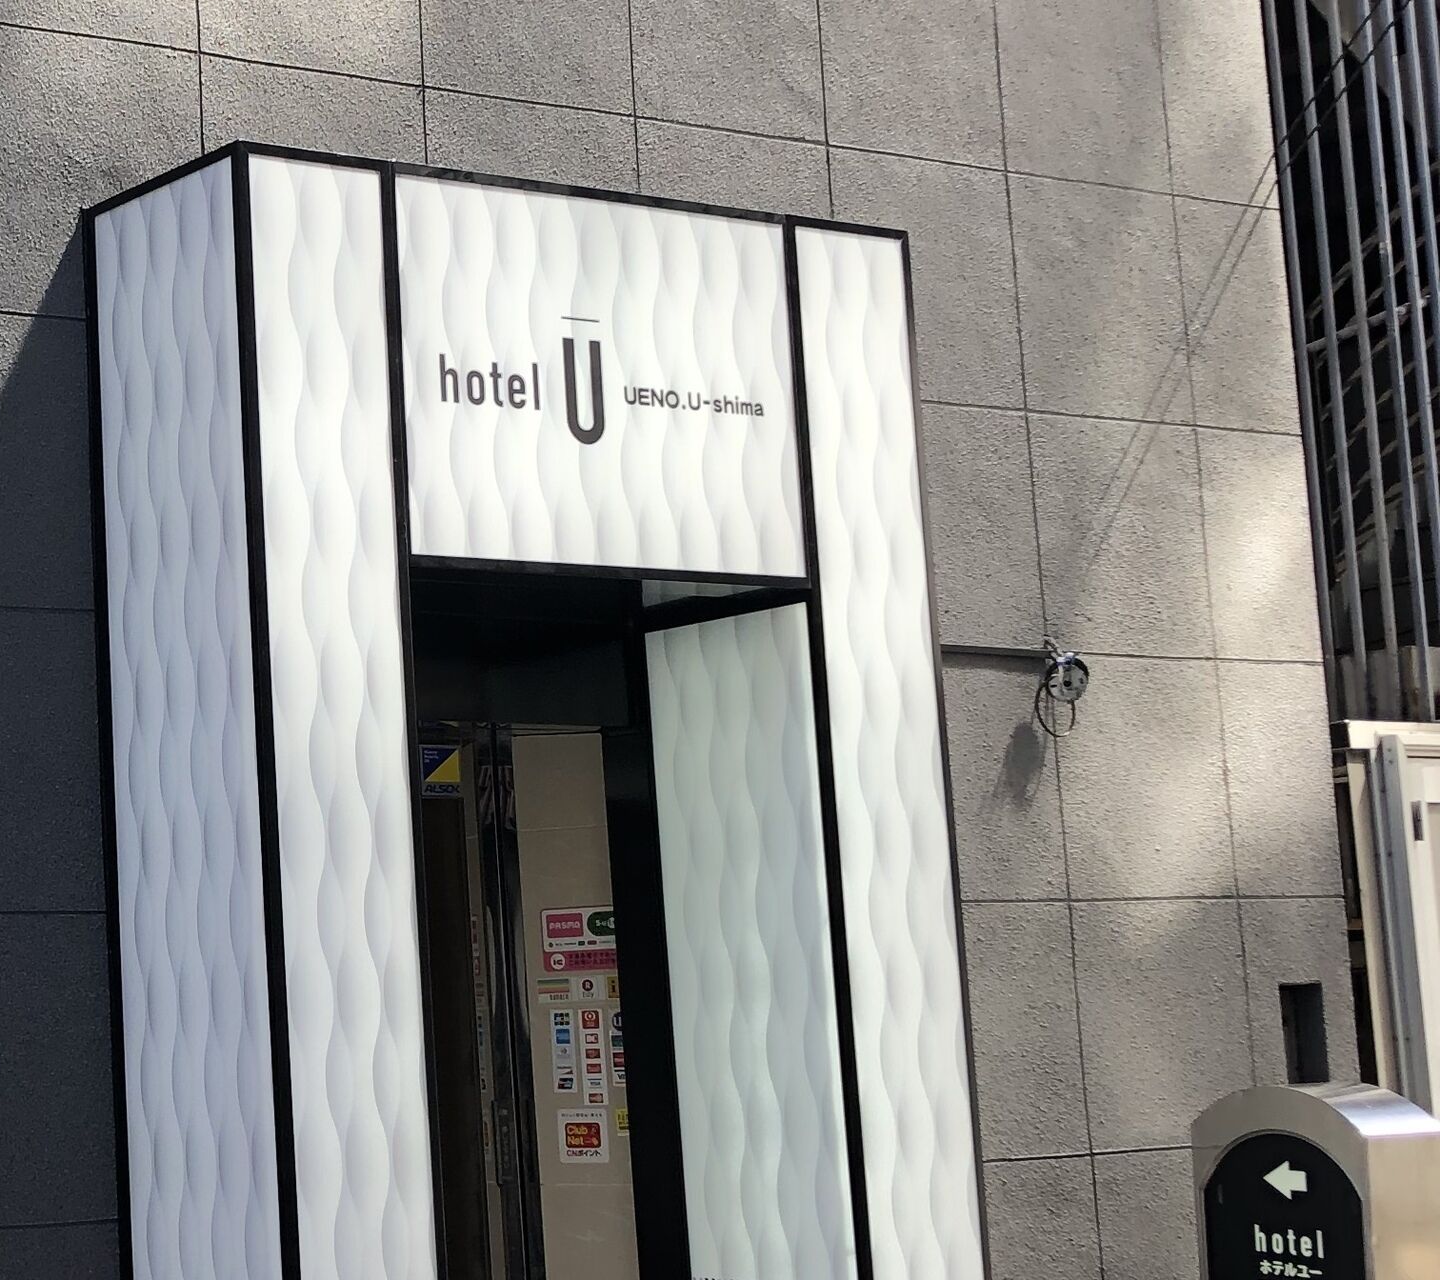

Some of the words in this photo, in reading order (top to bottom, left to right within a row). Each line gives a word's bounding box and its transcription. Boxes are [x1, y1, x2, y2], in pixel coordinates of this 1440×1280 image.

[439, 353, 541, 411] hotel
[623, 385, 765, 417] UENO.U-shima
[1253, 1223, 1325, 1259] hotel
[1259, 1259, 1323, 1279] ホテルユー
